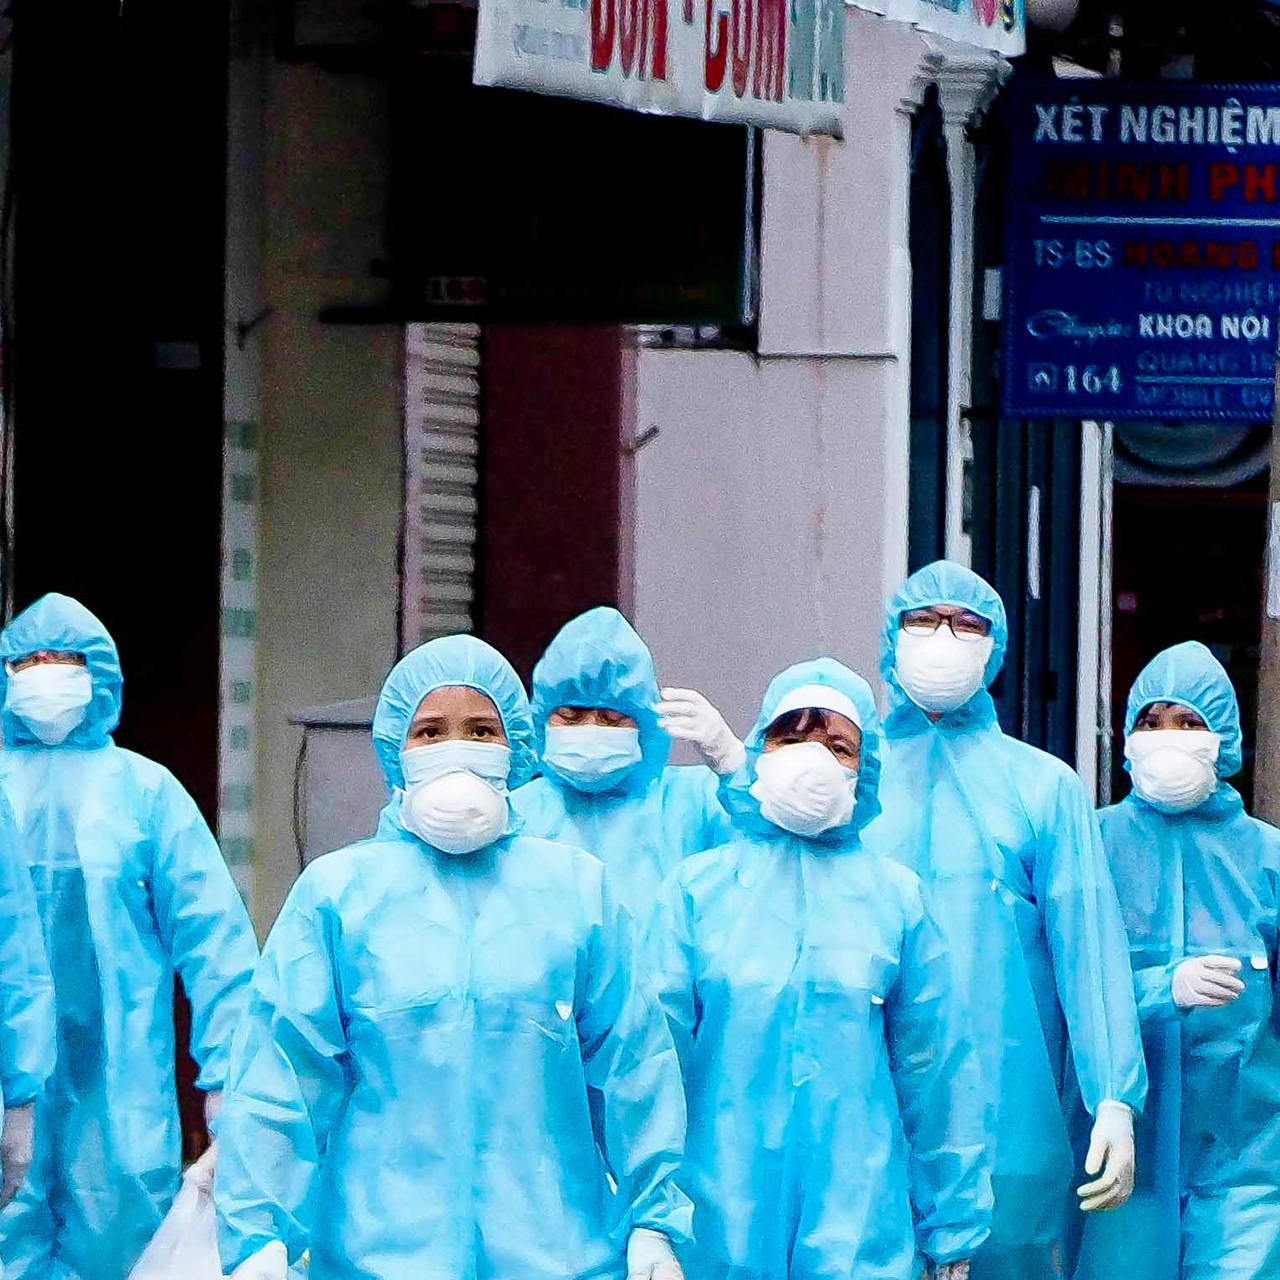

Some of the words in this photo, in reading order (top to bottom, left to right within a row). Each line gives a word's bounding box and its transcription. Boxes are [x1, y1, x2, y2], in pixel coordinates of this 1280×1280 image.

[1033, 95, 1109, 144] XÉT
[1120, 96, 1280, 154] NGHIỆM
[1063, 363, 1121, 395] 164
